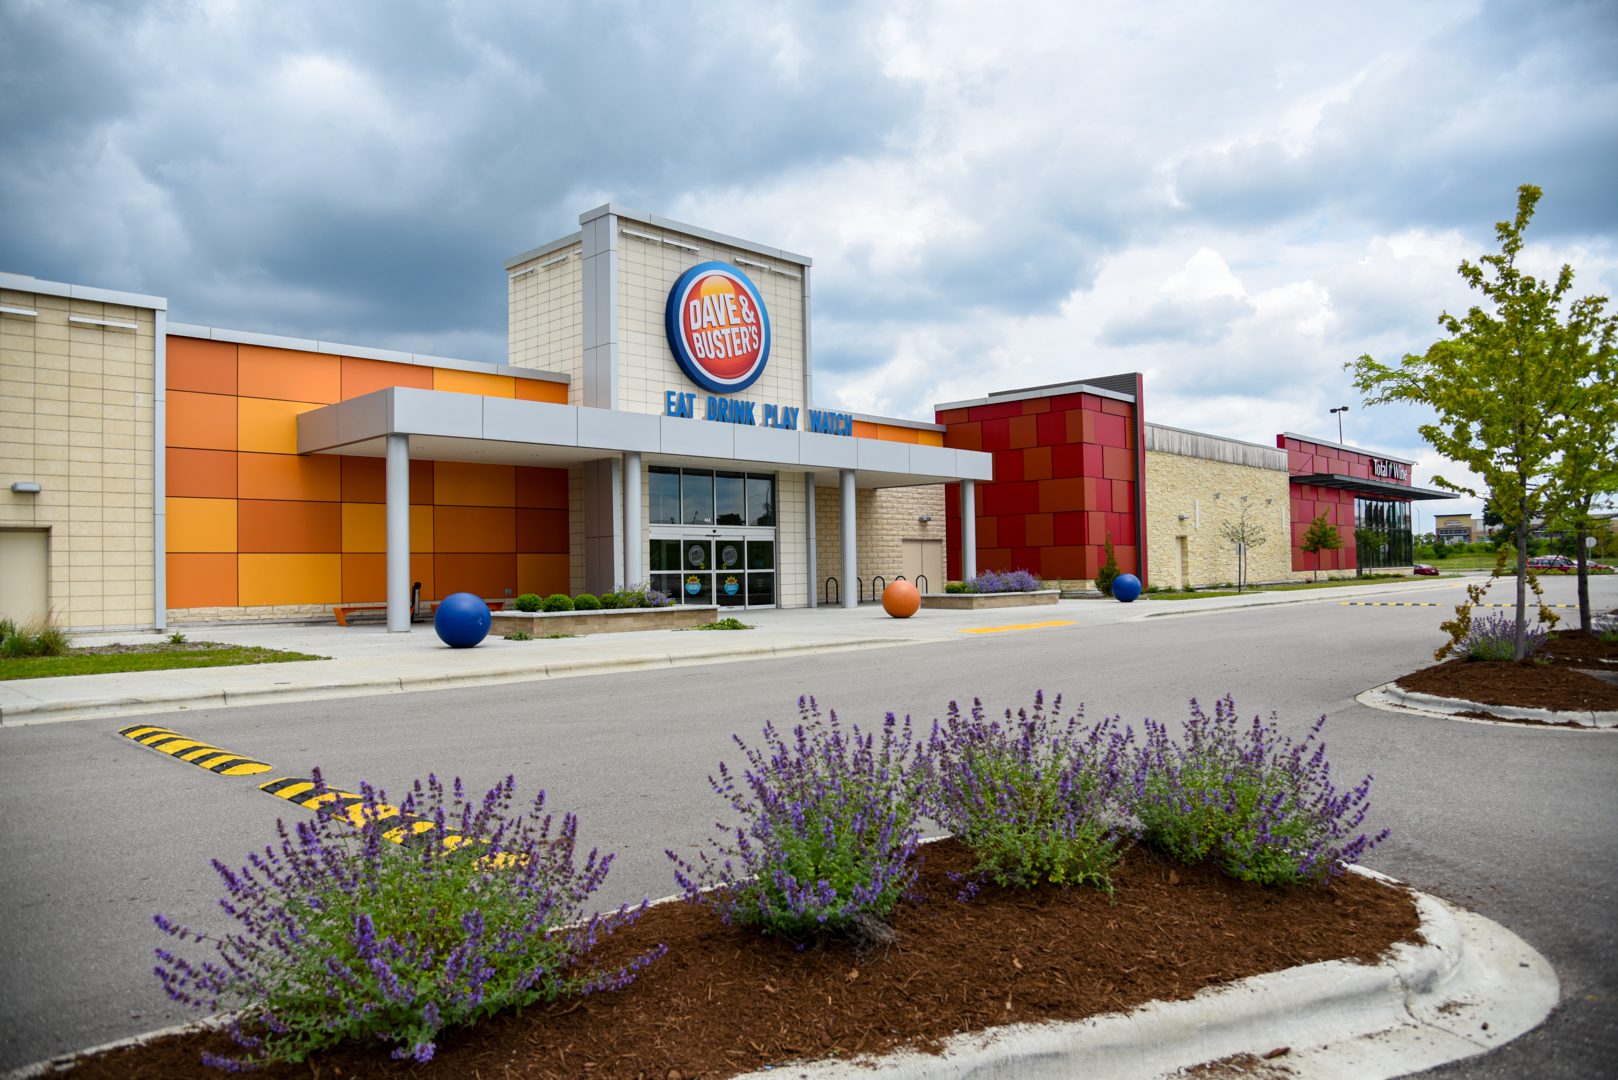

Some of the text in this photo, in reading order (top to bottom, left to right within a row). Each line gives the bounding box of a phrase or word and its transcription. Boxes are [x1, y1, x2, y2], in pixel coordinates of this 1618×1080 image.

[689, 293, 757, 331] DAVE &
[692, 325, 759, 359] BUSTER'S
[665, 390, 853, 436] EAT DRINK PLAY WATCH
[1373, 459, 1408, 481] Total Wine
